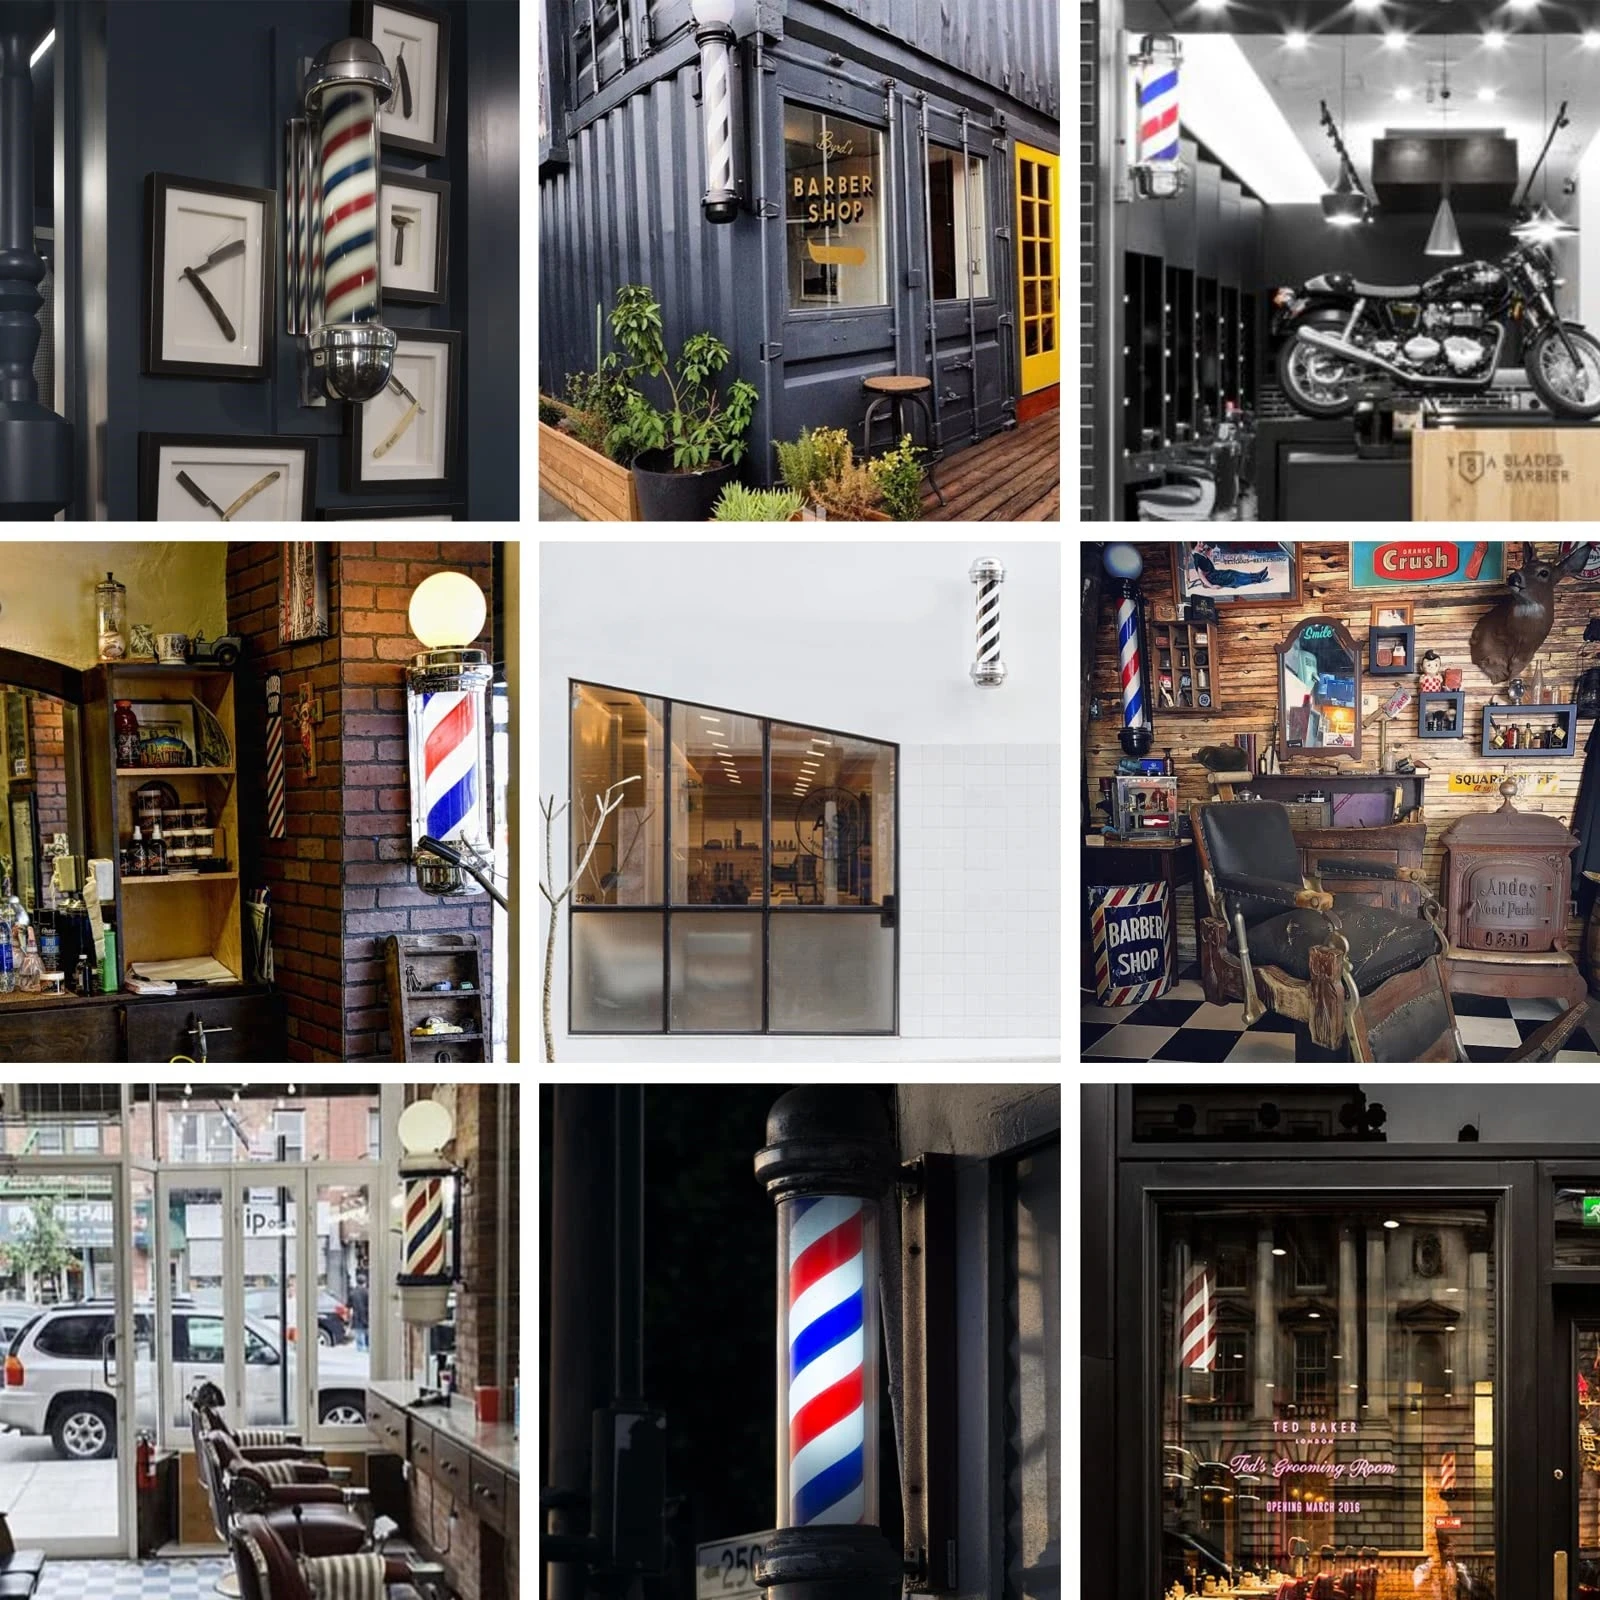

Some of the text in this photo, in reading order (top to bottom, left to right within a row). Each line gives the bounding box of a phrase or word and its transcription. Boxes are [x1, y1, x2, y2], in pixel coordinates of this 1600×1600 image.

[793, 175, 873, 198] BARBER
[808, 200, 863, 223] SHOP
[1382, 546, 1448, 571] Crush
[1402, 547, 1431, 555] ORANGE
[1480, 877, 1537, 898] Andes
[1108, 915, 1163, 948] BARBER
[1117, 947, 1159, 976] SHOP
[1273, 1421, 1357, 1433] TED BAKER
[1230, 1454, 1397, 1478] Ted's Grooming Room
[1266, 1501, 1361, 1513] OPENING MARCH 2016
